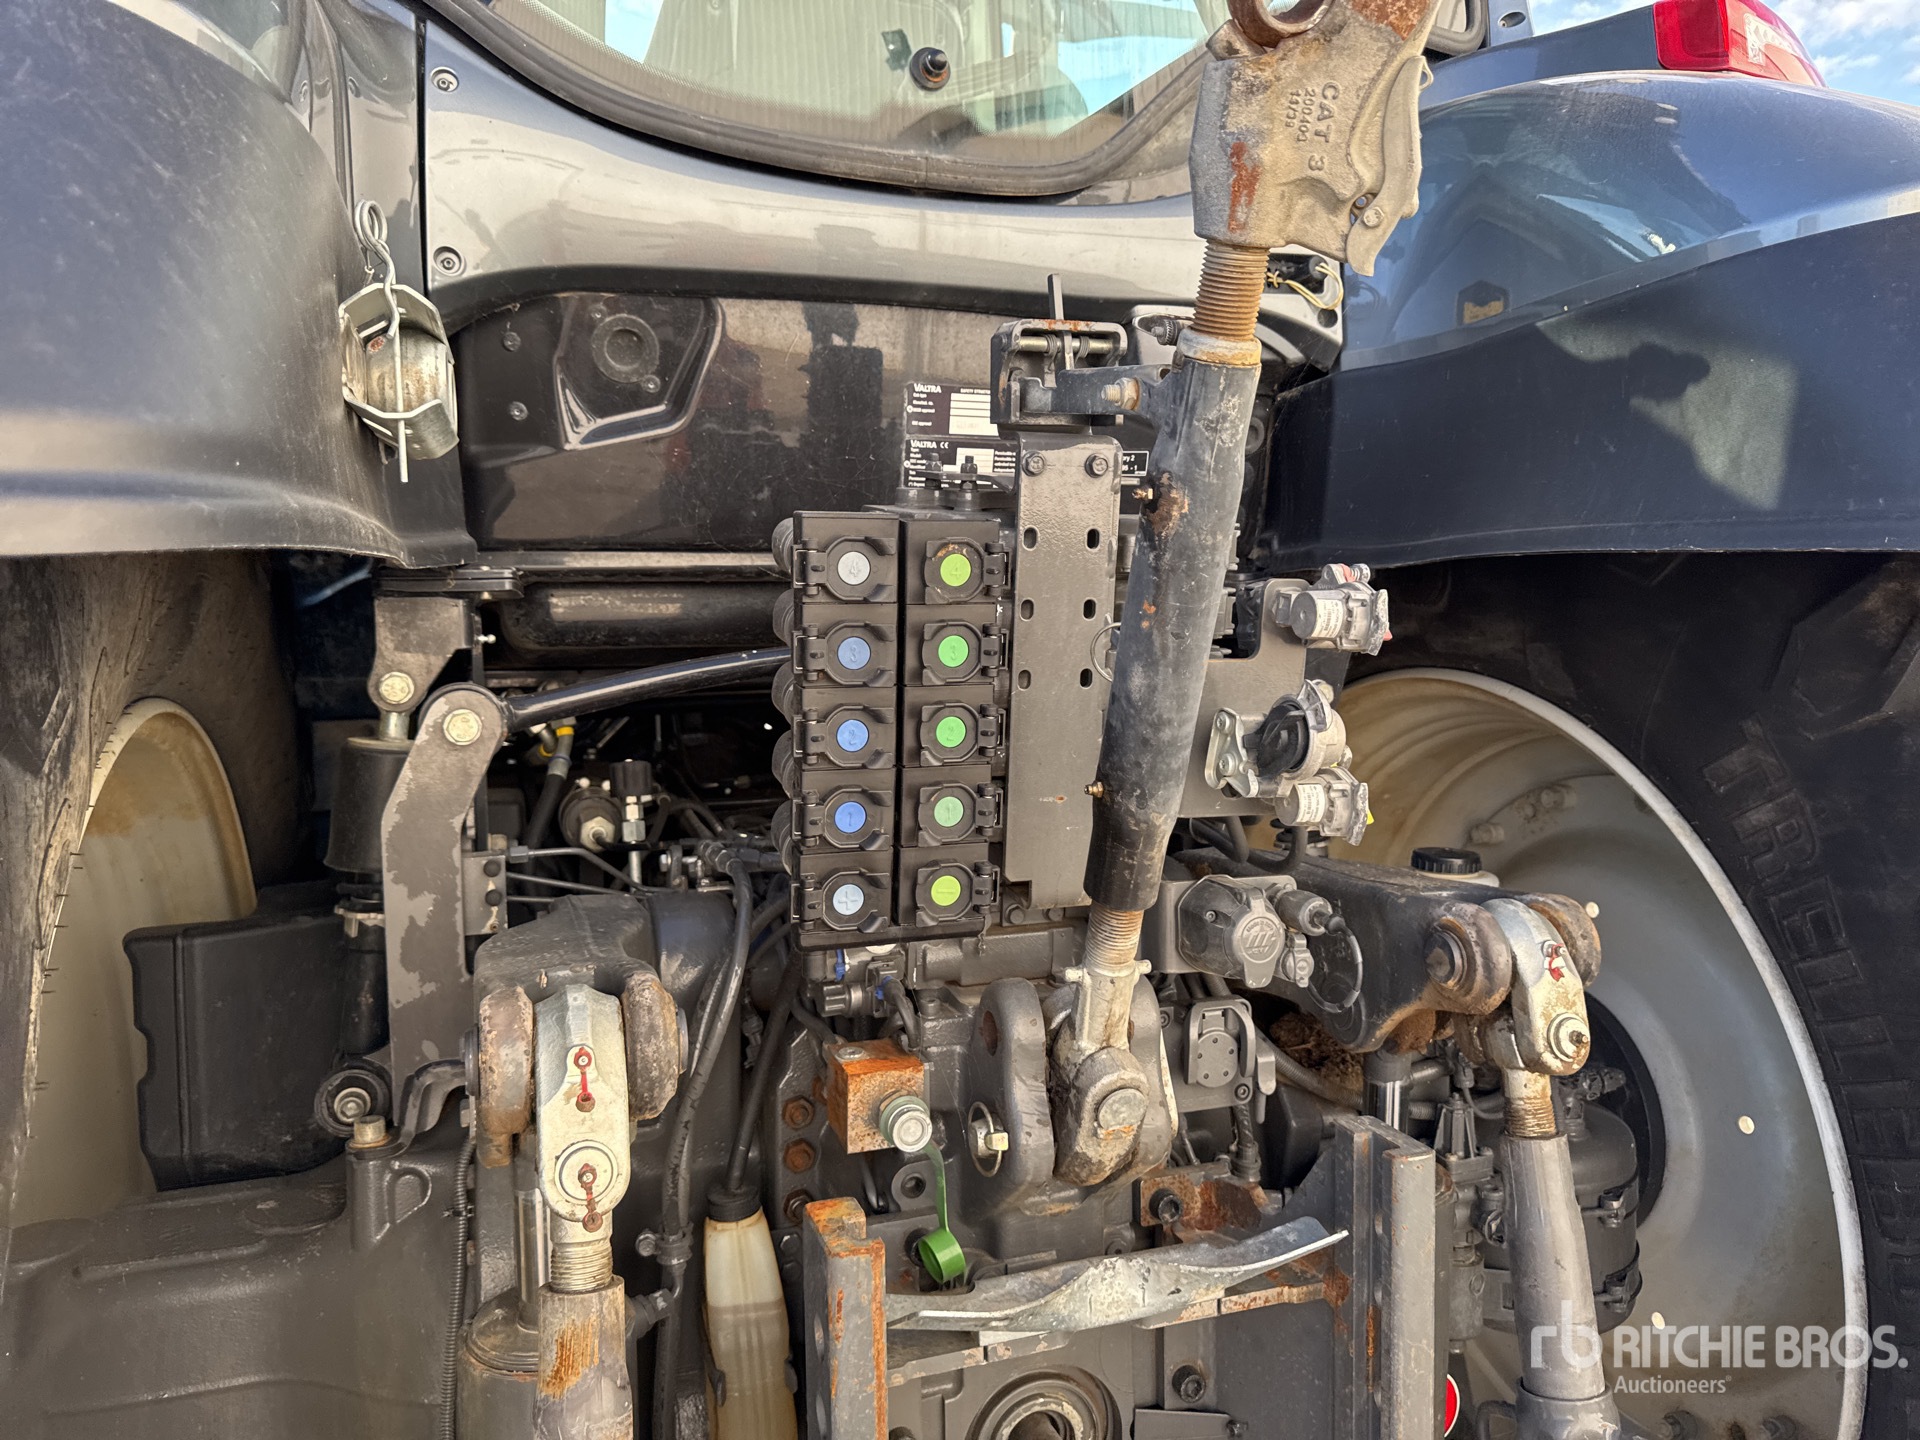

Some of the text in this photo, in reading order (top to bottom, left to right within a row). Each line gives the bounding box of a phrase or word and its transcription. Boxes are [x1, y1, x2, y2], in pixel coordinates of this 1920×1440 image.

[1308, 81, 1341, 173] CAT 3
[914, 384, 942, 393] VALTRA
[911, 440, 936, 448] VALTRA
